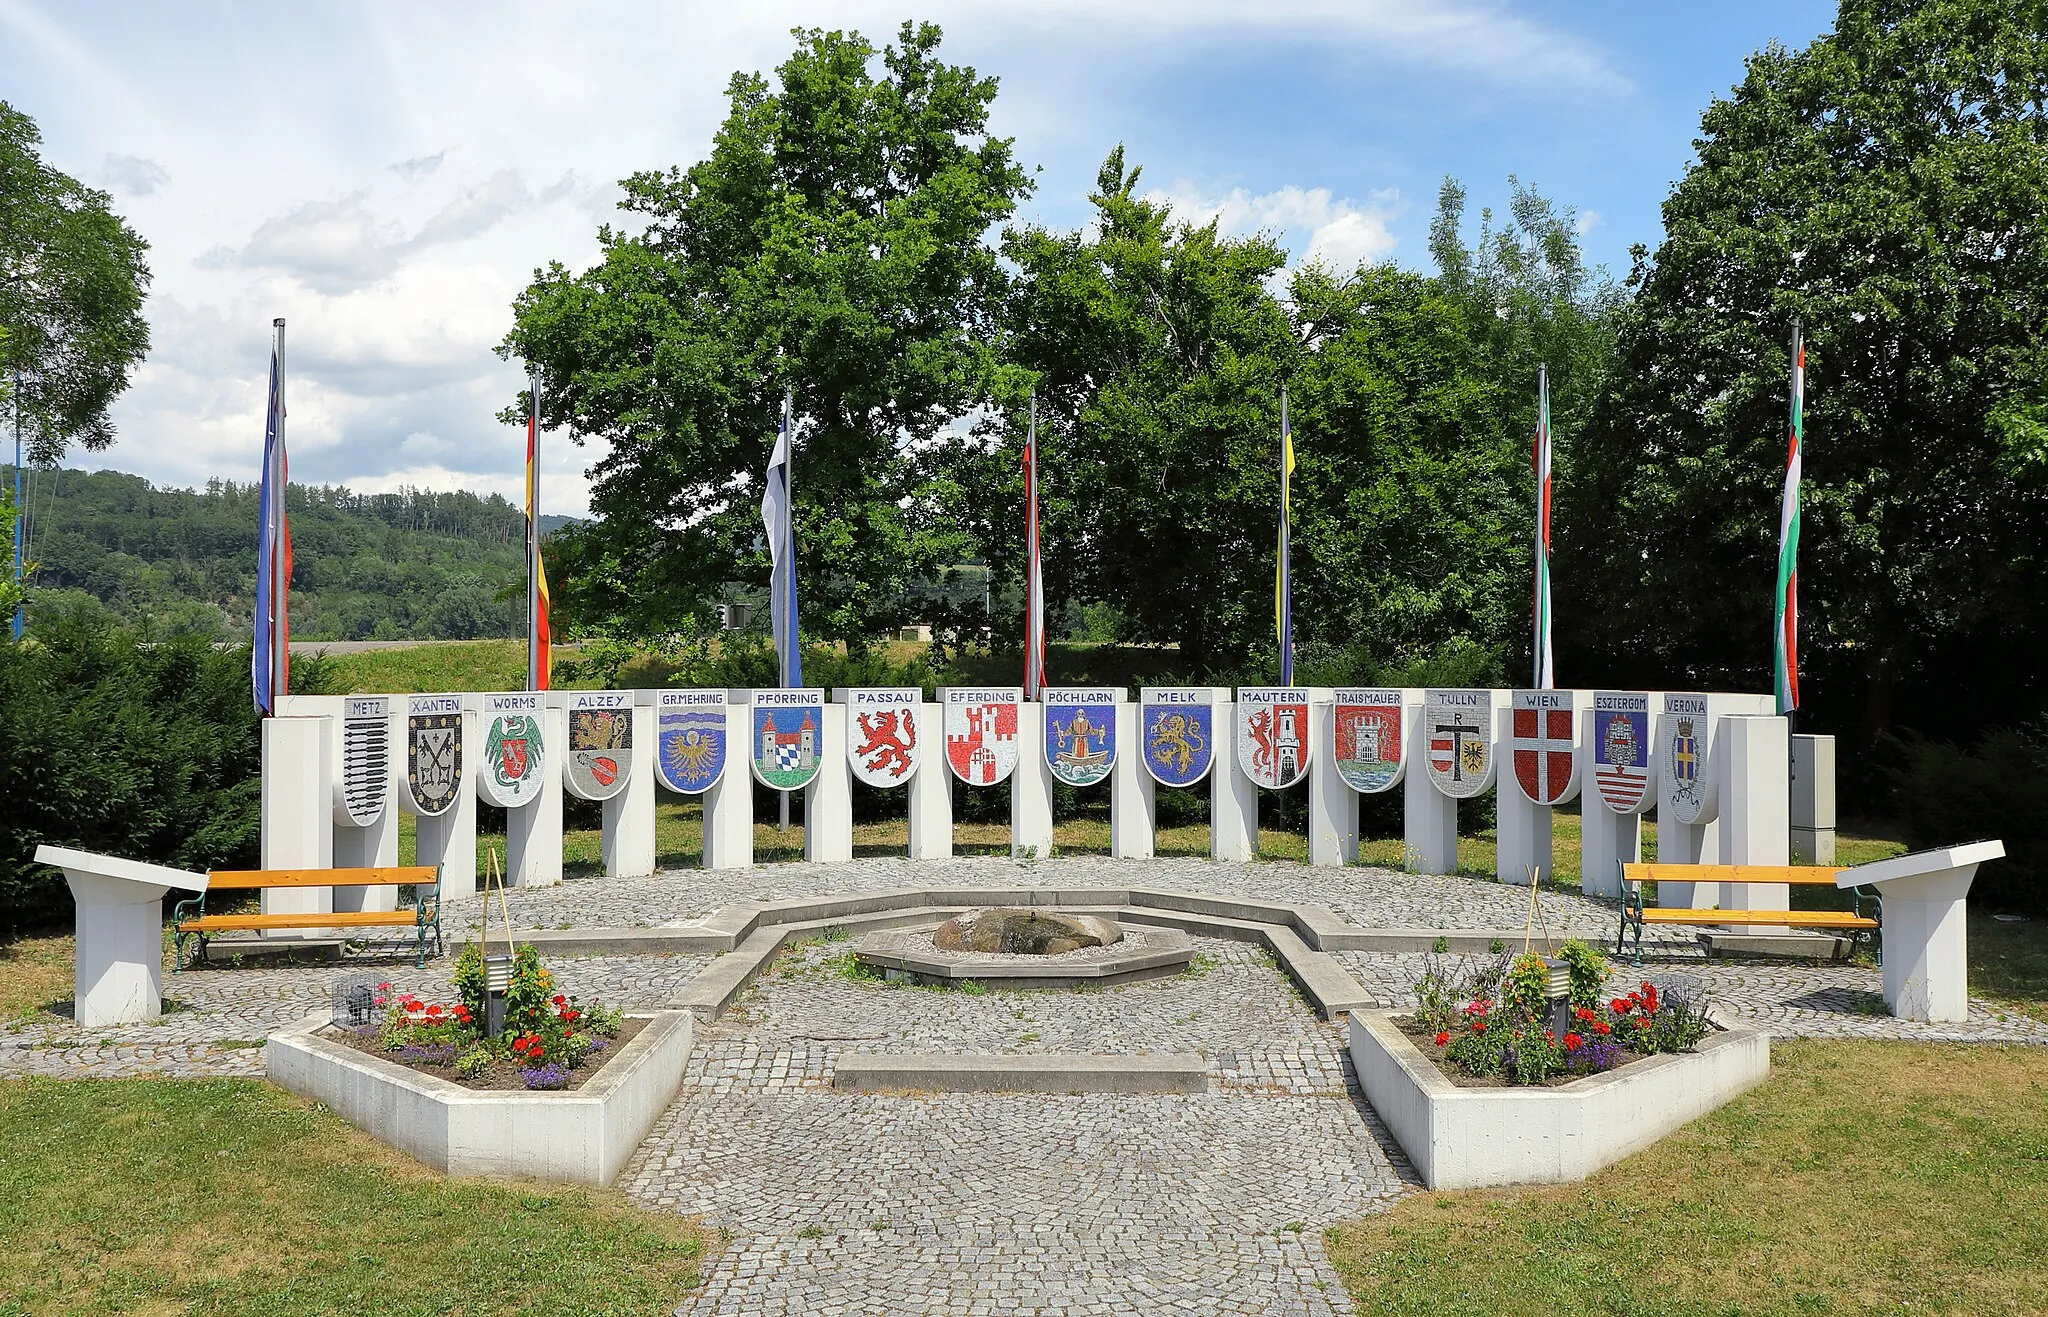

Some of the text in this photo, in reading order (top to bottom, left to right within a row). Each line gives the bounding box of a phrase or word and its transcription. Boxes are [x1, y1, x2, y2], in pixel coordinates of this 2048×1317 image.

[493, 697, 538, 709] WORMS
[577, 695, 625, 707] ALZEY
[662, 694, 723, 705] GR.MEHRING
[757, 692, 818, 704] PFÖRRING
[857, 693, 914, 703] PASSAU
[951, 692, 1015, 703] EFERDING
[1048, 691, 1113, 703] PÖCHLARN
[1157, 692, 1196, 703] MELK
[1241, 692, 1306, 703] MAUTERN
[1336, 693, 1401, 704] TRAISMAUER
[1439, 694, 1477, 705] TULLN
[1526, 695, 1559, 707] WIEN
[353, 702, 380, 715] METZ
[412, 699, 460, 713] XANTEN
[1596, 697, 1647, 711] ESZTERGOM
[1666, 700, 1707, 713] VERONA
